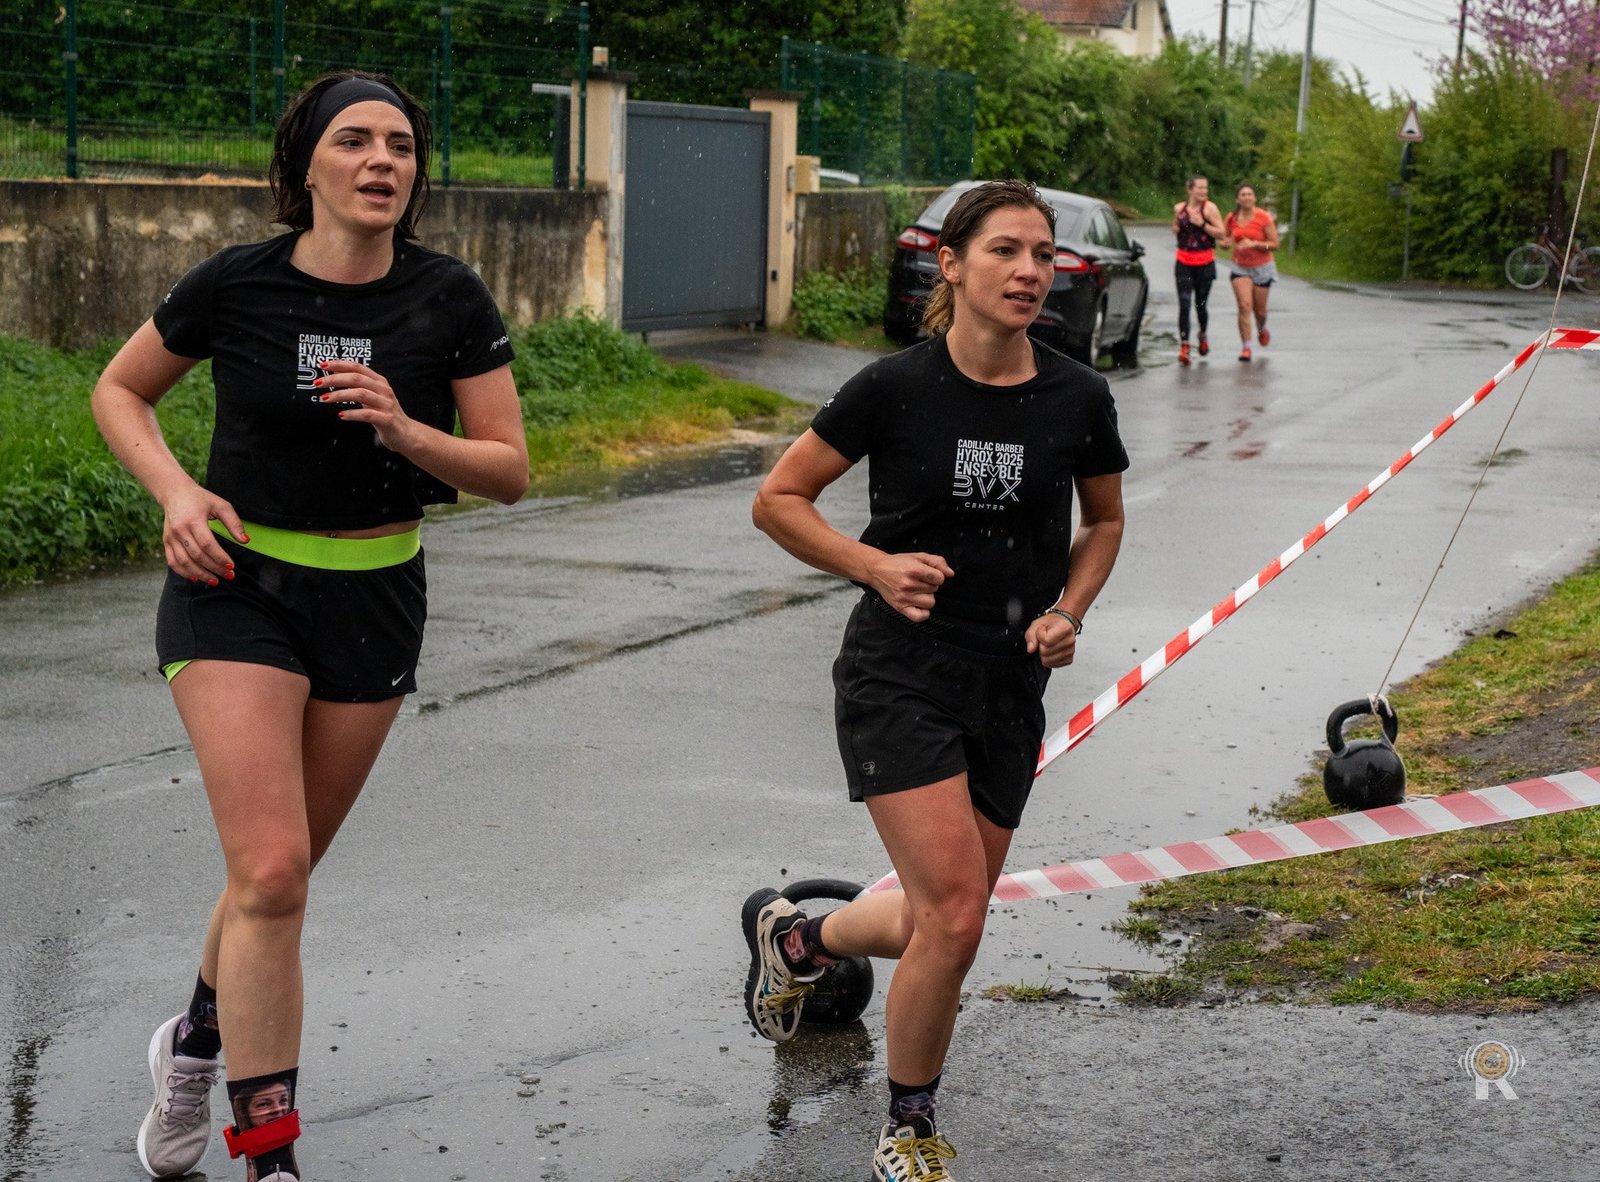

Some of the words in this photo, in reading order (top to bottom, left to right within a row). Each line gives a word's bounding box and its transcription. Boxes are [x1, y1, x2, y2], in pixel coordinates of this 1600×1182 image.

[299, 333, 338, 345] CADILLAC
[340, 337, 371, 347] BARBER
[299, 343, 338, 357] HYROX
[341, 346, 372, 358] 2025
[958, 439, 994, 451] CADILLAC
[995, 443, 1024, 454] BARBER
[957, 448, 994, 464] HYROX
[996, 452, 1023, 466] 2025
[964, 501, 1005, 511] CENTER
